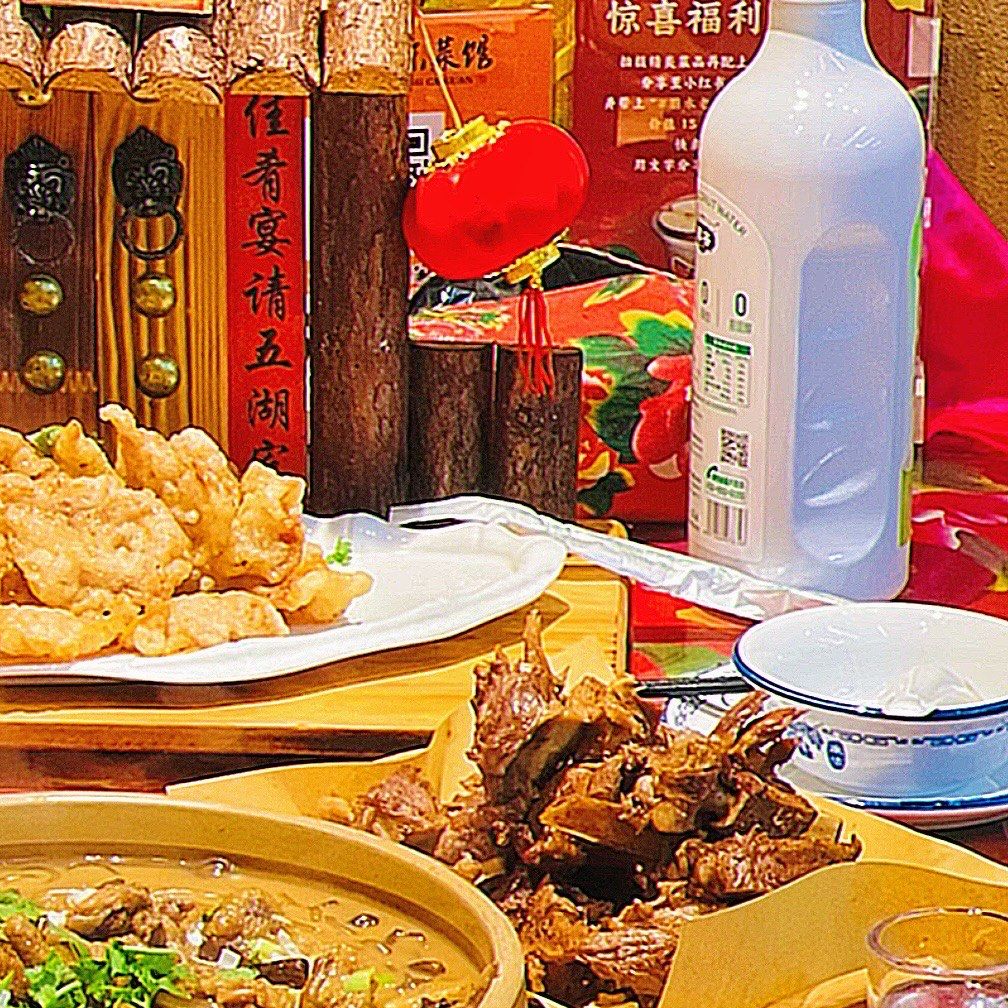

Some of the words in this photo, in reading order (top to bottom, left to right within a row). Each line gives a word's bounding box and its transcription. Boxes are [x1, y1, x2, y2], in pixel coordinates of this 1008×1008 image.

[605, 0, 761, 36] 惊喜福利
[735, 292, 748, 318] 0
